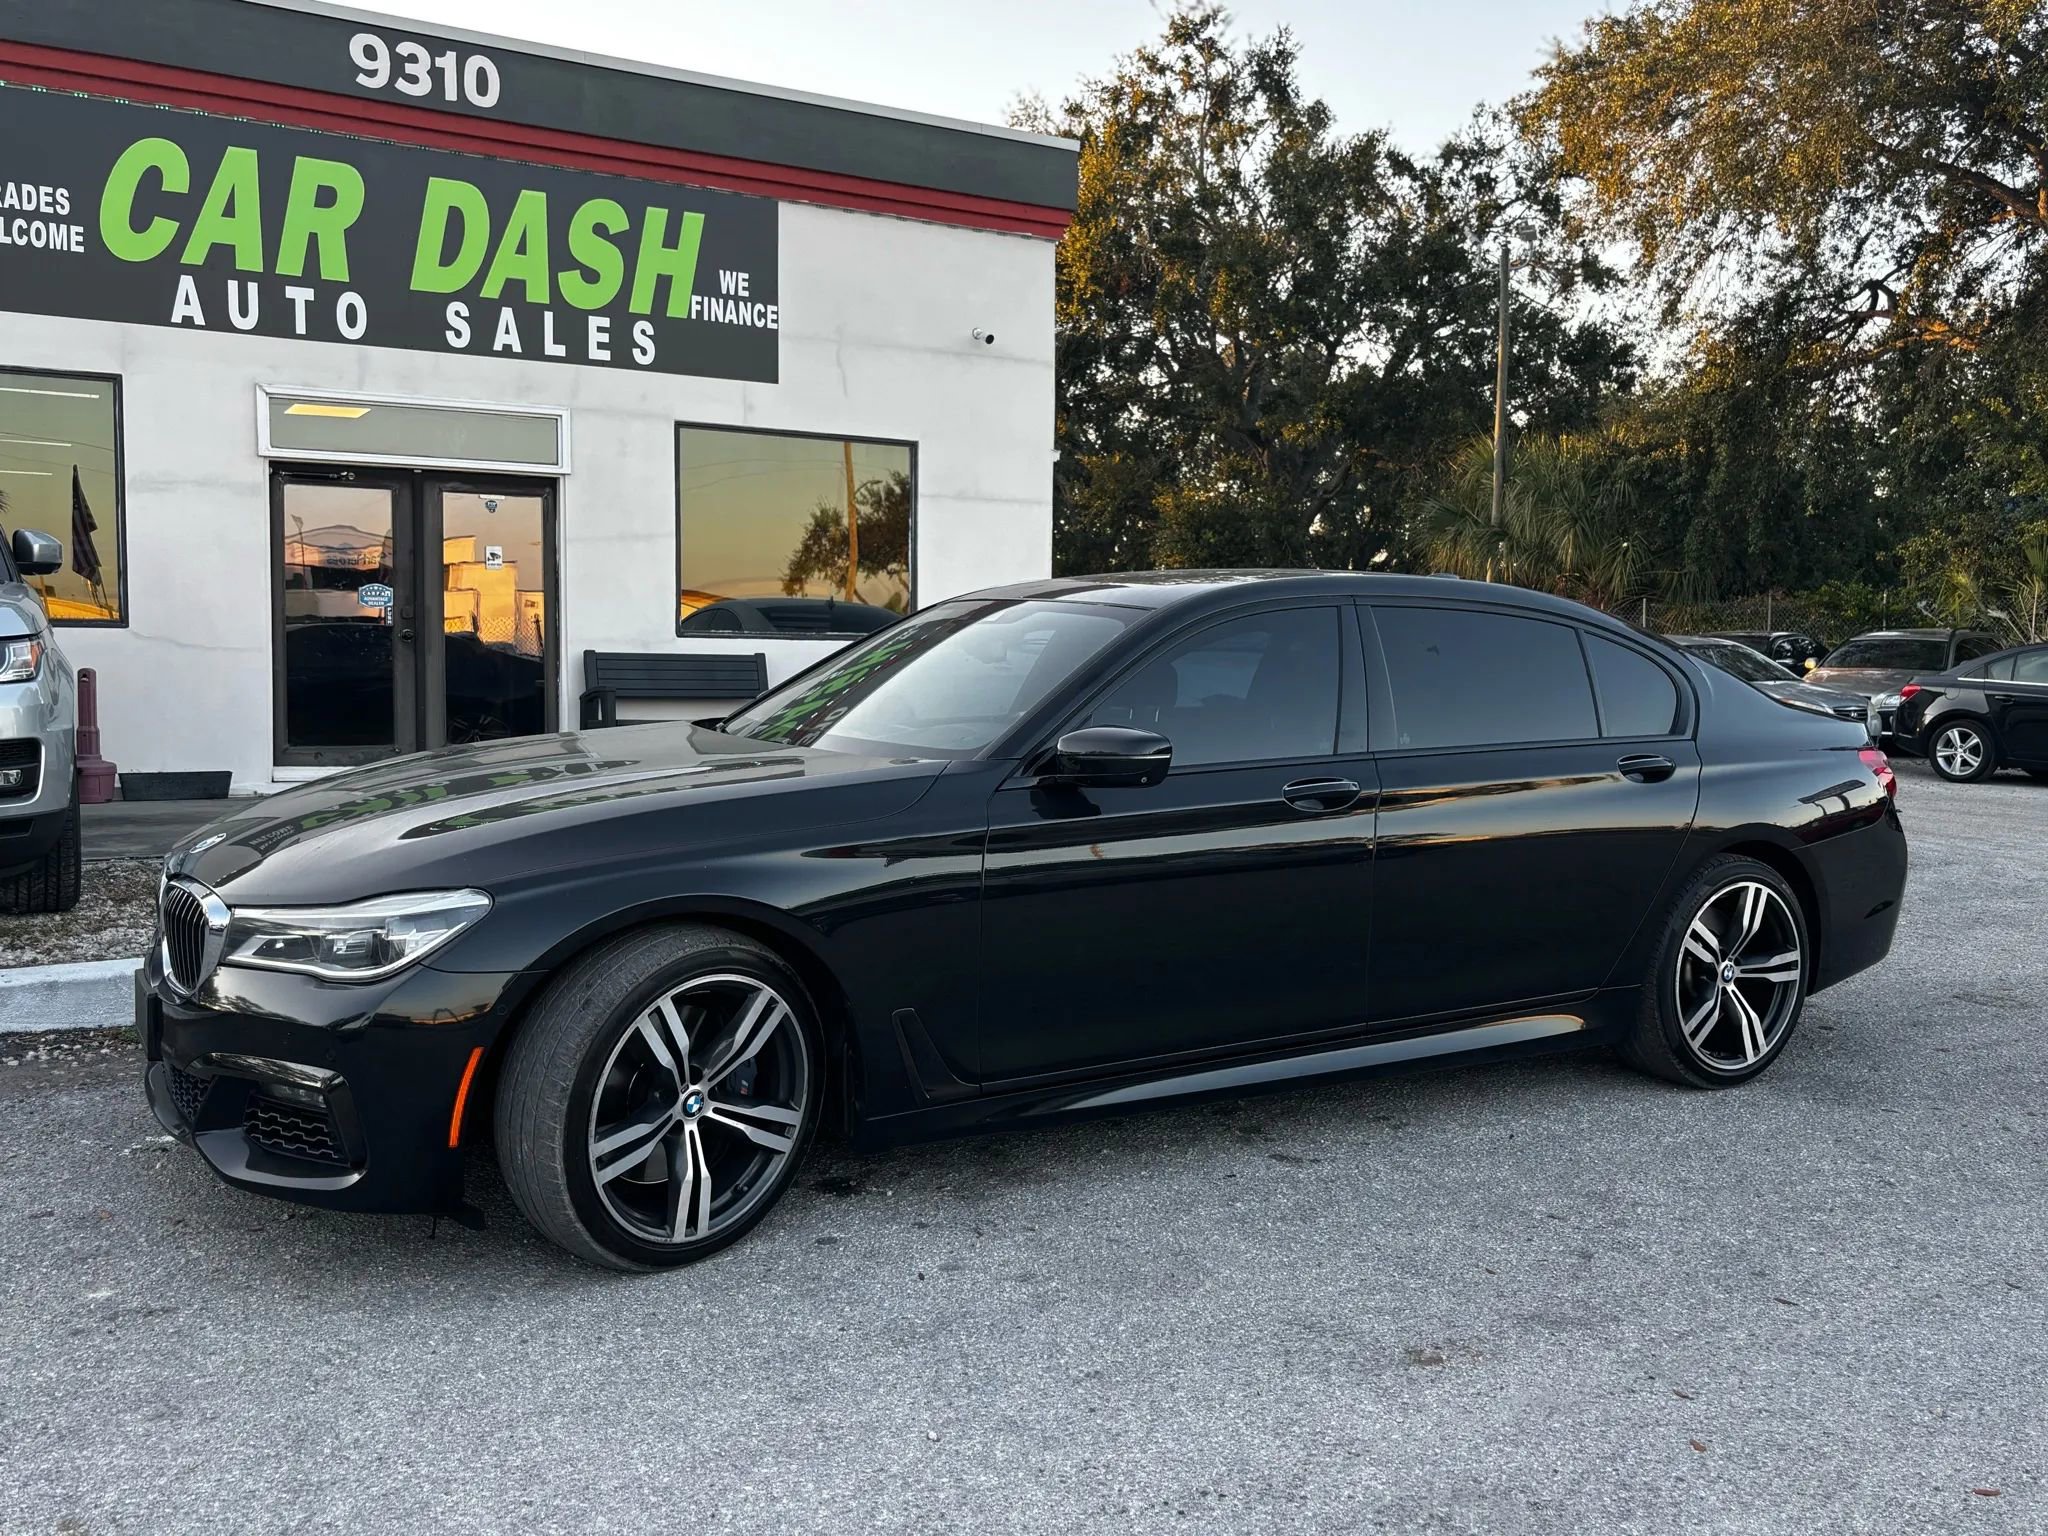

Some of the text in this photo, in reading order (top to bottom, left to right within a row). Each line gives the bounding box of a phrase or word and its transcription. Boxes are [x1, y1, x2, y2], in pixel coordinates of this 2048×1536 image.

[349, 34, 501, 108] 9310
[0, 182, 70, 215] ADES
[99, 138, 705, 319] CAR DASH
[719, 269, 749, 297] WE
[171, 275, 655, 366] AUTO SALES
[691, 295, 779, 330] FINANCE
